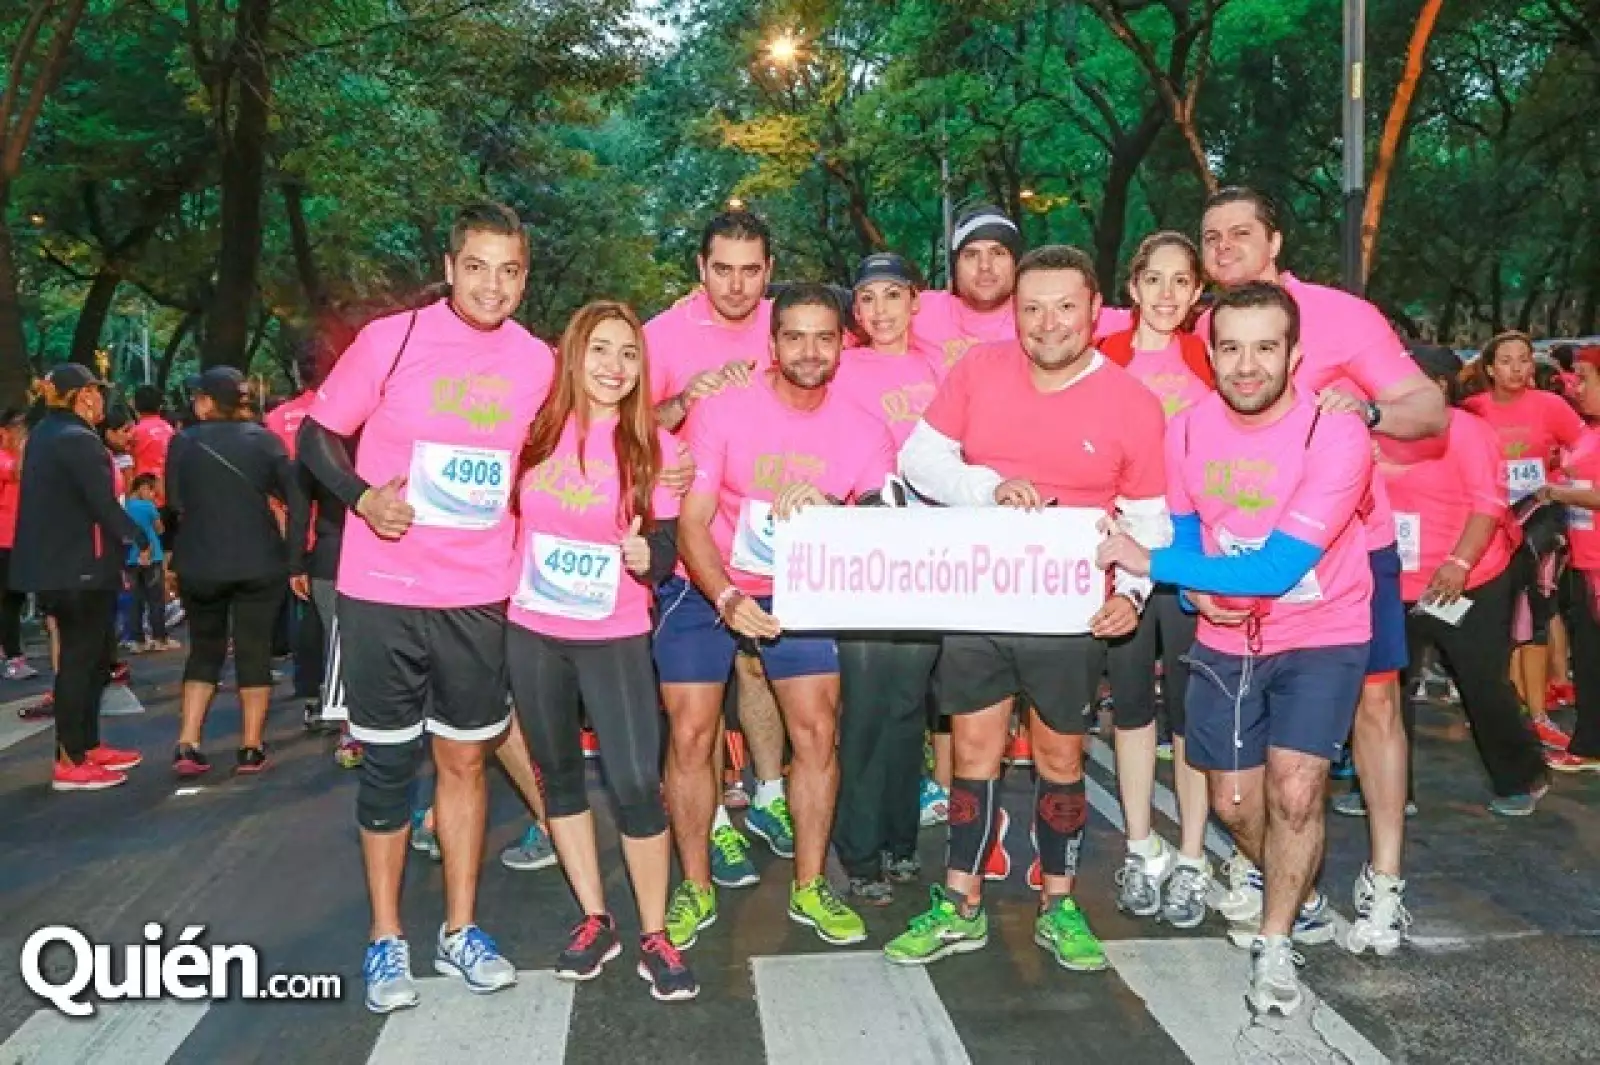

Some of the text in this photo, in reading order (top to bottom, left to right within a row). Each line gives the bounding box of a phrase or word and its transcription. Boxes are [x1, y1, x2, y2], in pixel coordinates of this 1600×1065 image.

[442, 456, 502, 486] 4908
[544, 548, 611, 579] 4907
[786, 541, 1092, 596] #UnaOraciónPorTere
